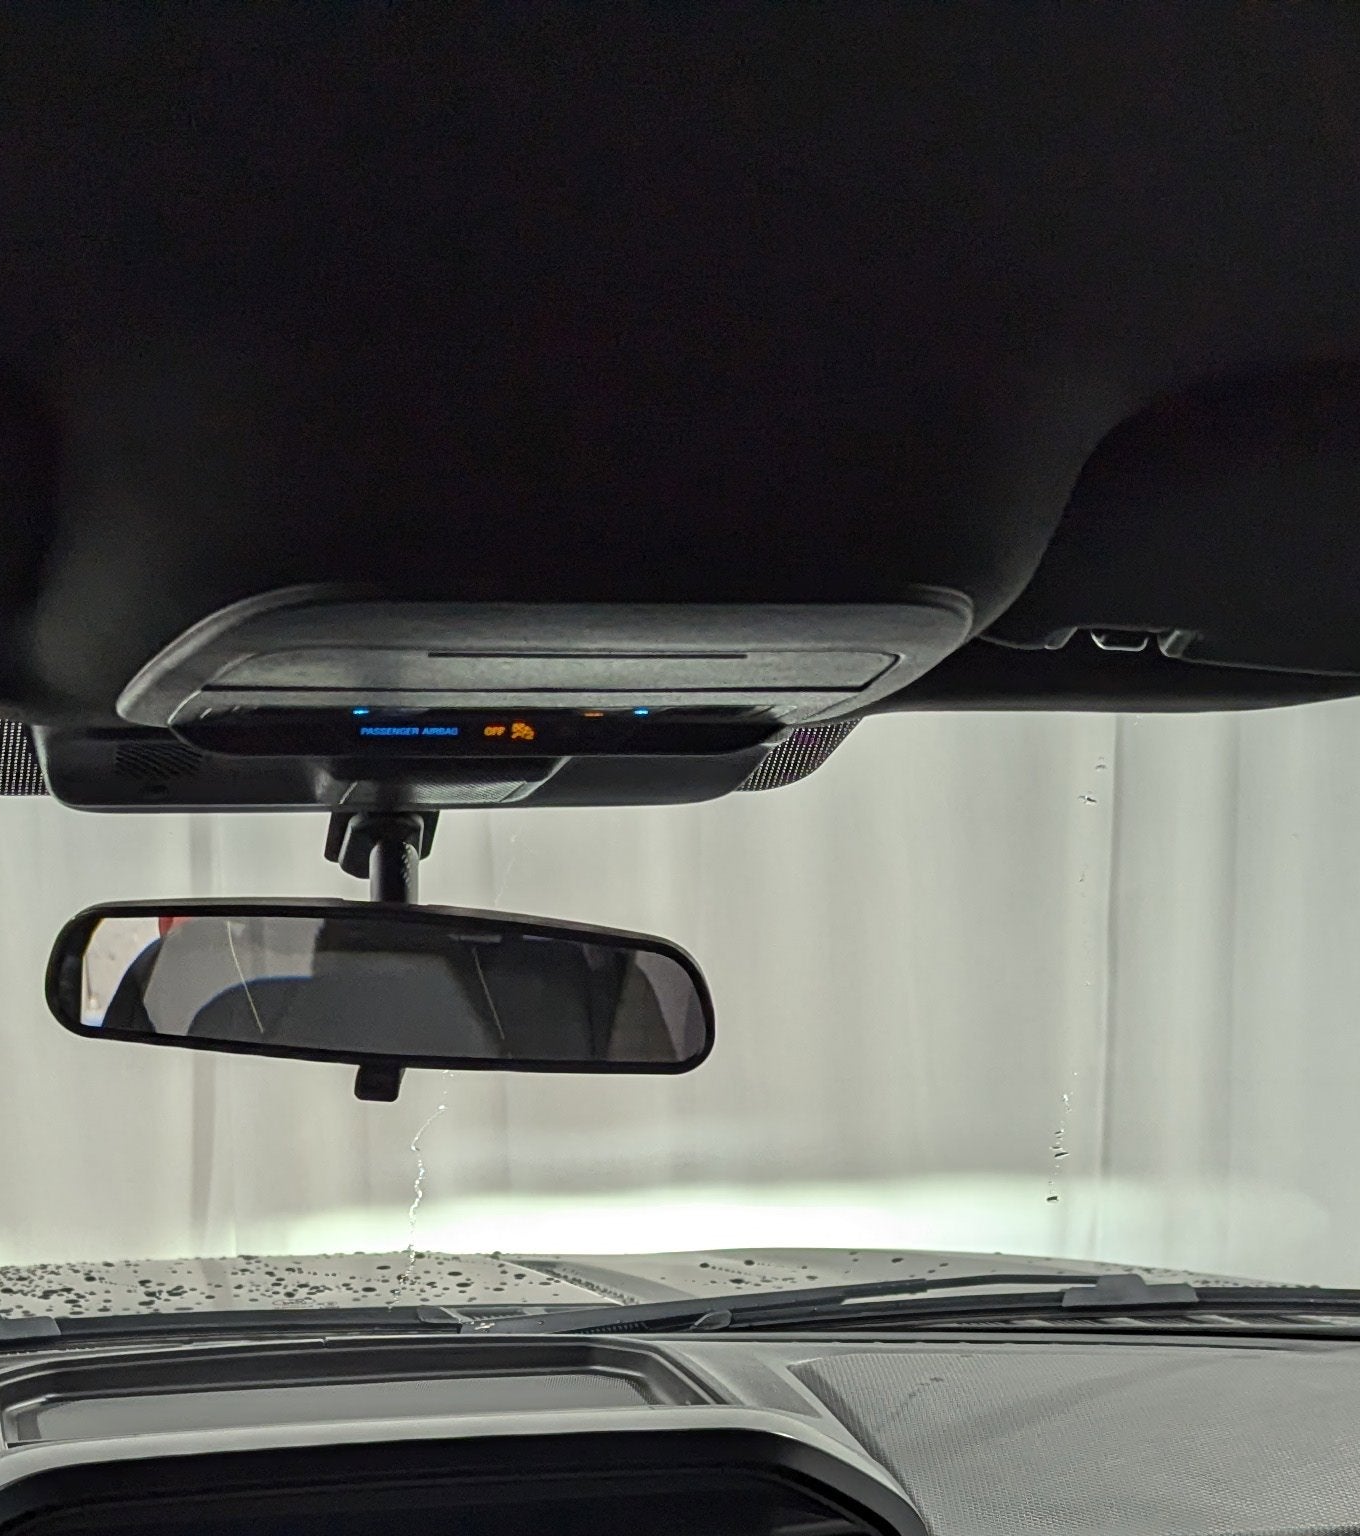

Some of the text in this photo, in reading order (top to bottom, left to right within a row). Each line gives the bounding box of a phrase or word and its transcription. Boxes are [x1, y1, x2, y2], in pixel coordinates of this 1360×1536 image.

[360, 726, 505, 736] PASSENGER AIRBAG OFF
